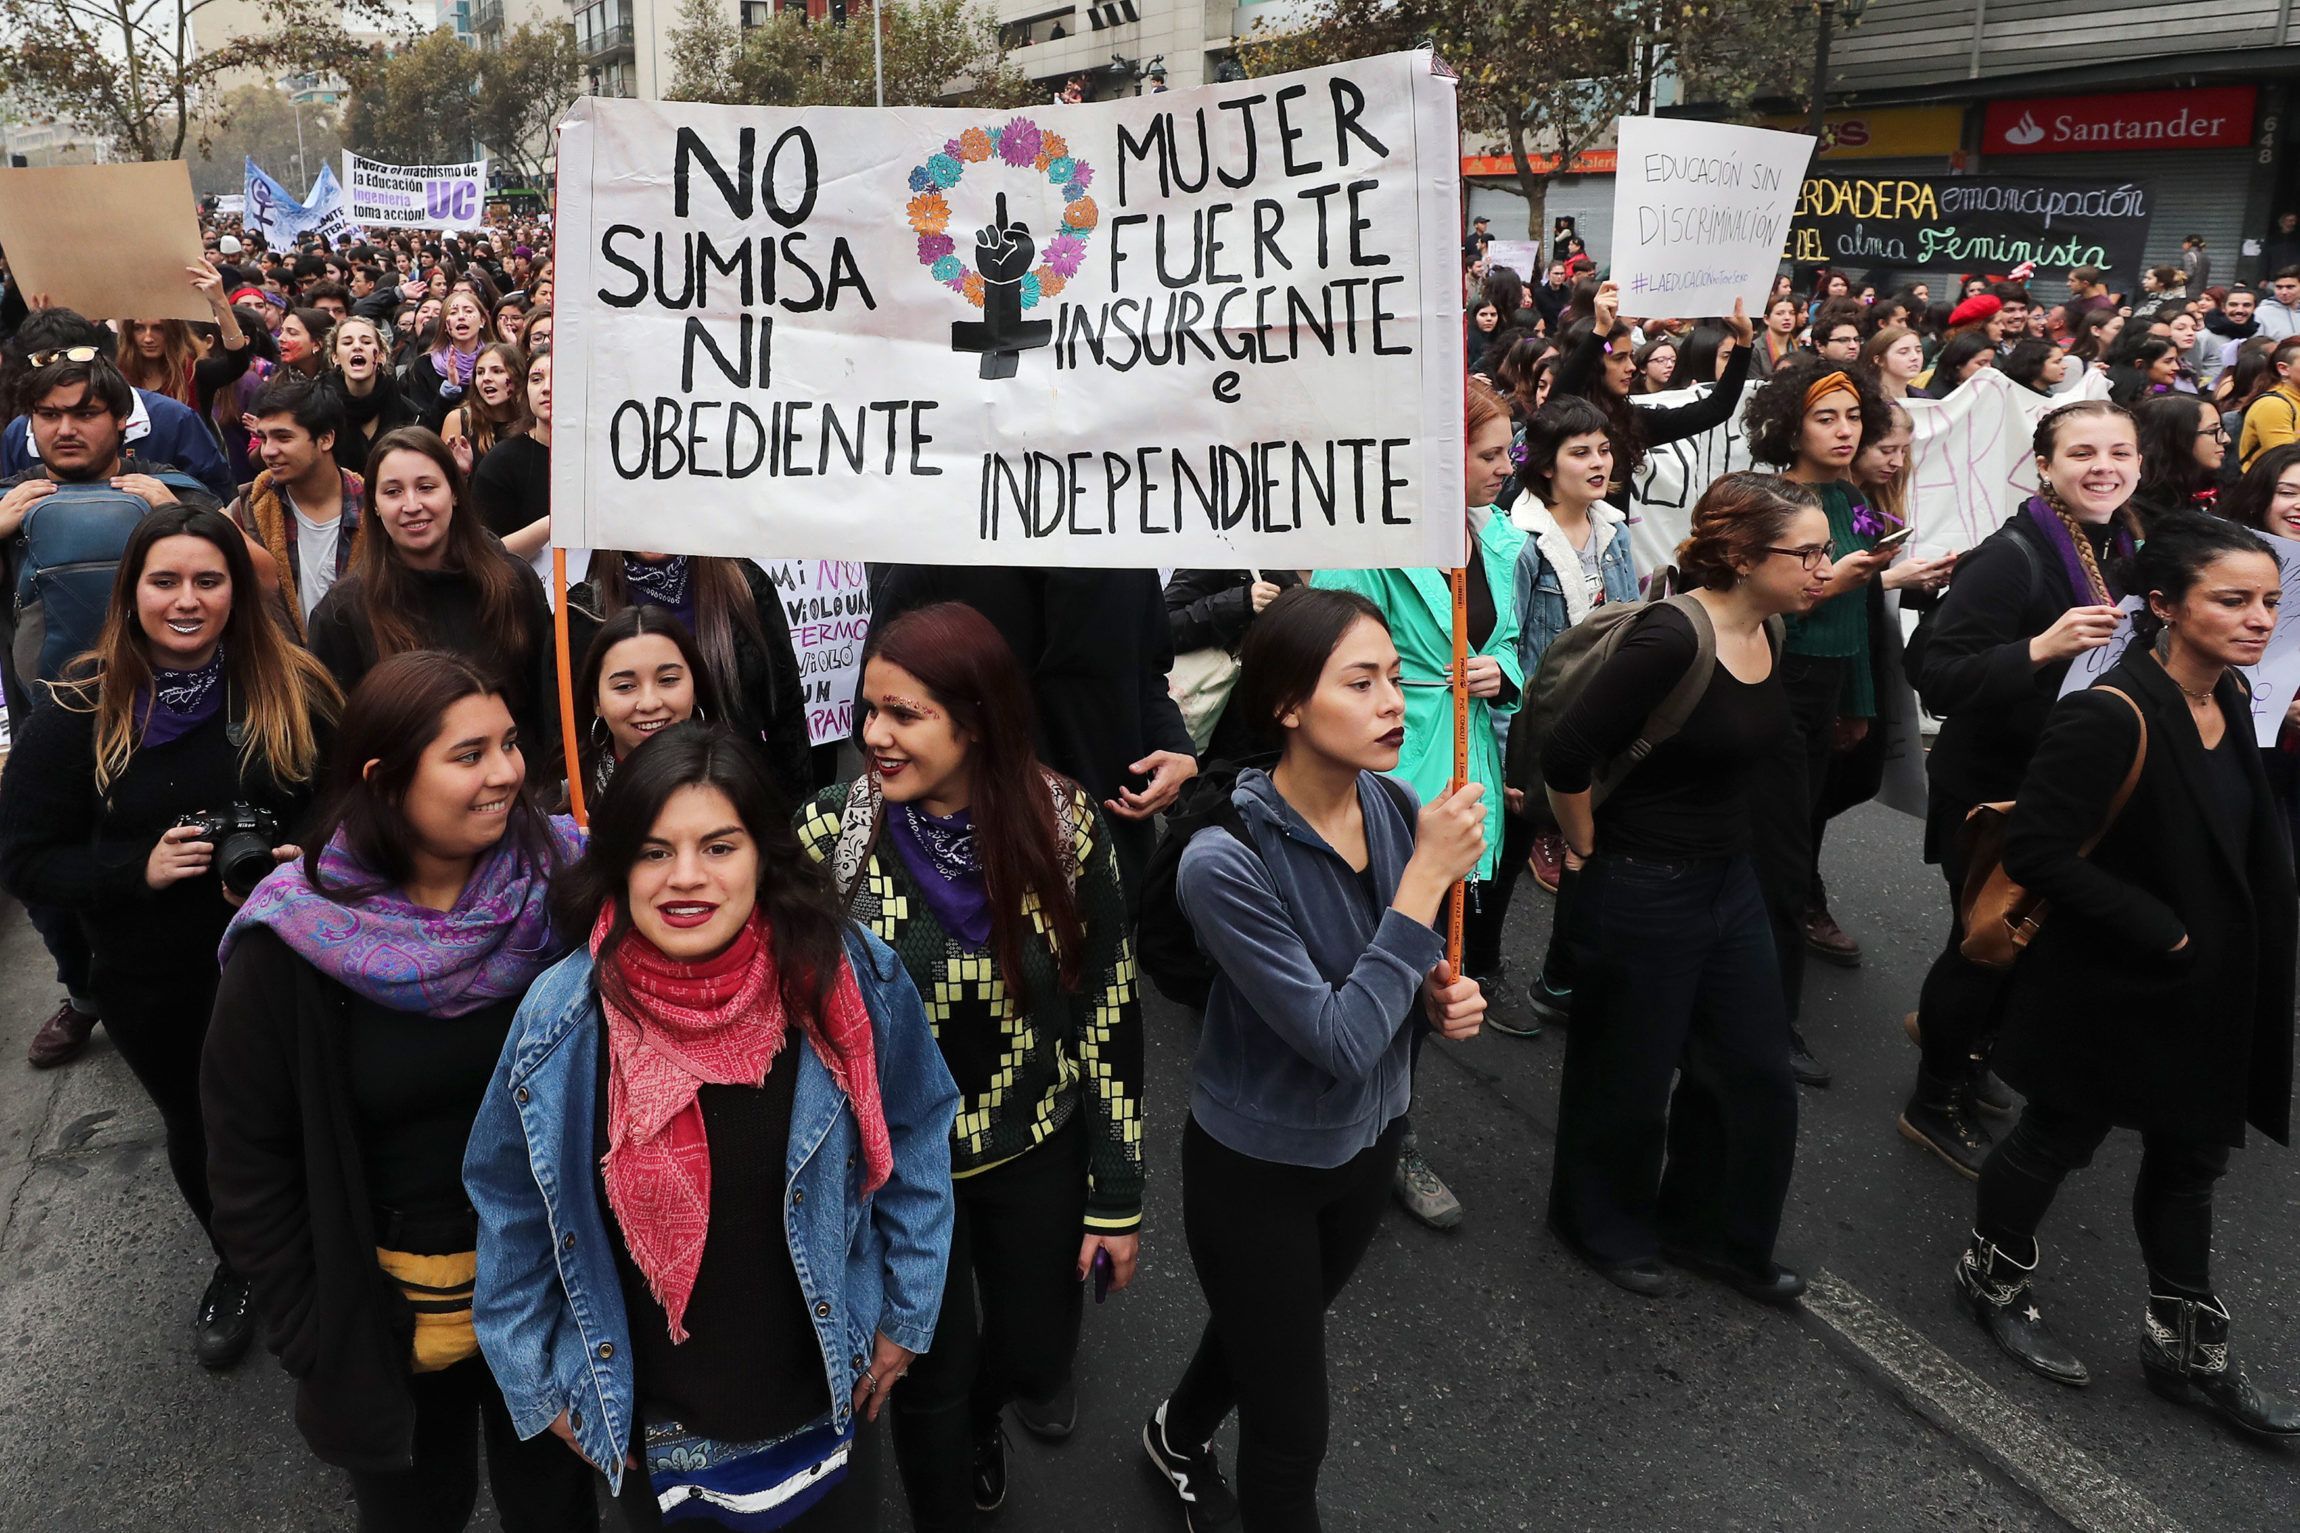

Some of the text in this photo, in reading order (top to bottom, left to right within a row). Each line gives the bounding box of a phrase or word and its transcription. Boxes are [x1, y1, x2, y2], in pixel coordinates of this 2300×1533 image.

[1117, 76, 1390, 207] MUJER
[2053, 107, 2226, 142] Santander
[353, 171, 423, 193] la Educación
[403, 165, 462, 178] machismo
[464, 164, 478, 177] de
[674, 125, 818, 229] NO
[1644, 150, 1782, 192] EDUCACIÓN SIN
[354, 204, 381, 219] toma
[426, 180, 477, 221] UC
[1940, 183, 2146, 230] emancipación
[1111, 179, 1391, 293] FUERTE
[1796, 228, 1831, 261] DEL
[1837, 223, 1908, 260] alma
[1917, 226, 2112, 270] Feminista
[597, 224, 877, 313] SUMISA
[1054, 275, 1413, 373] INSURGENTE
[681, 313, 773, 394] NI
[1212, 370, 1241, 404] e
[609, 396, 943, 480] OBEDIENTE
[979, 438, 1412, 541] INDEPENDIENTE
[845, 587, 871, 616] UN
